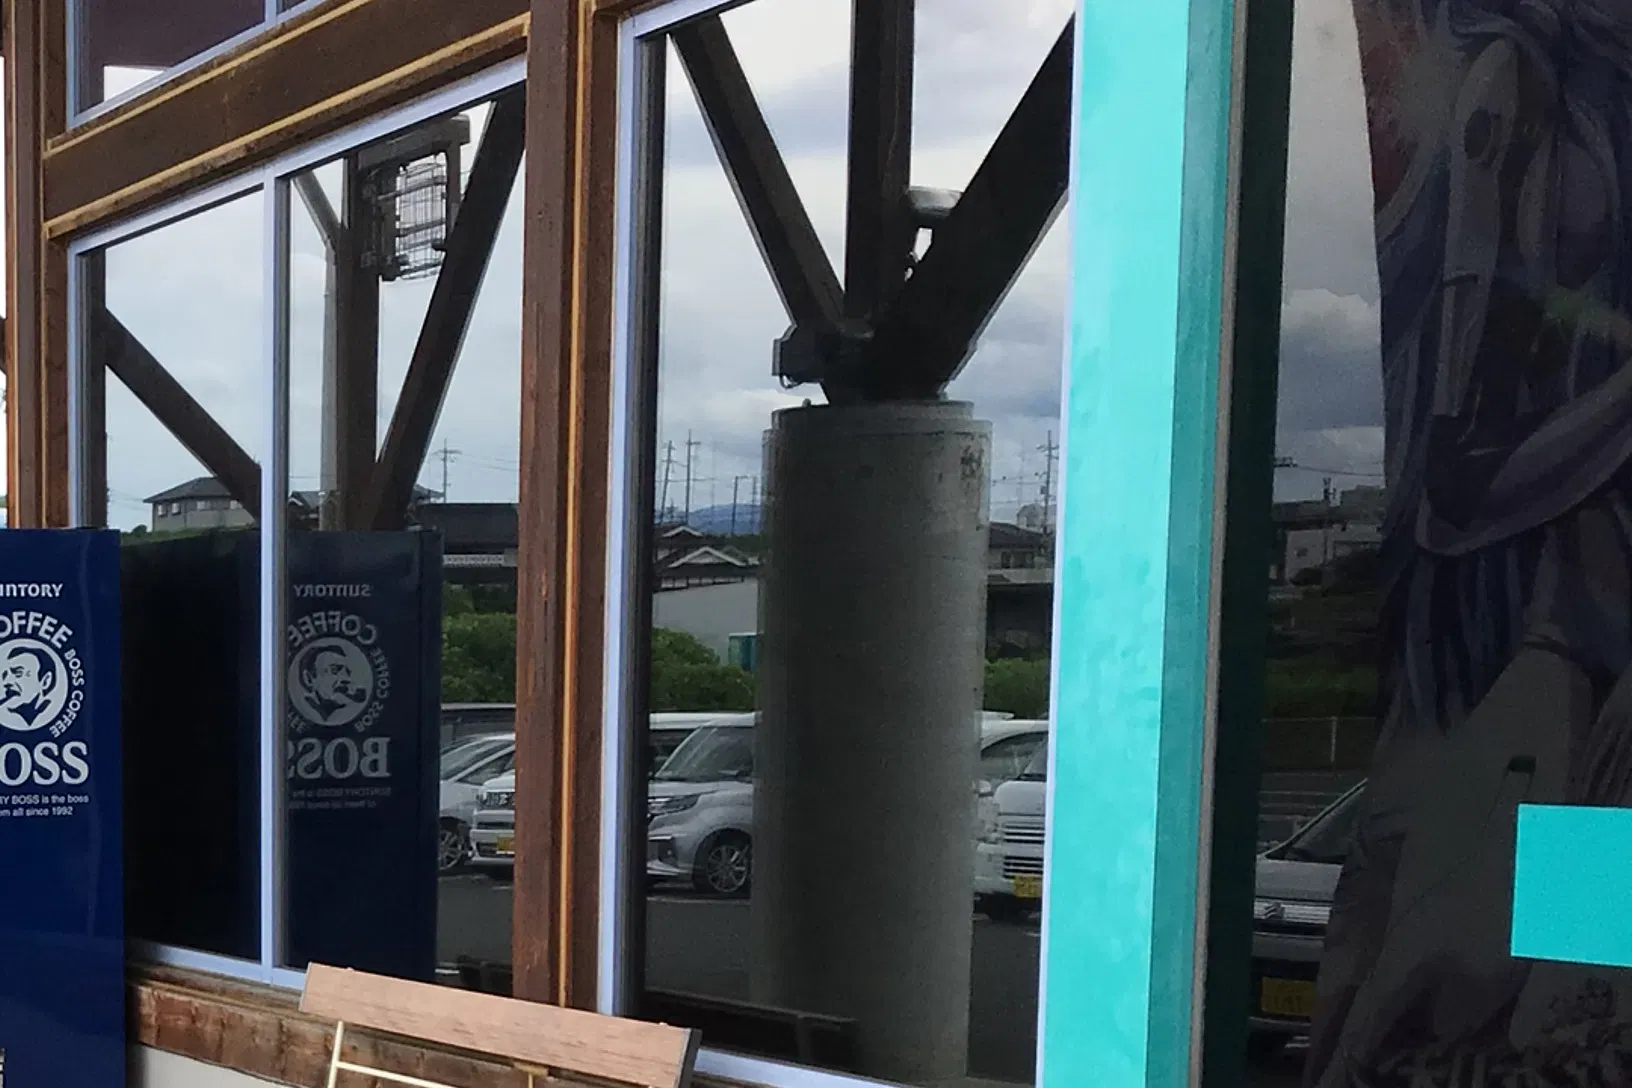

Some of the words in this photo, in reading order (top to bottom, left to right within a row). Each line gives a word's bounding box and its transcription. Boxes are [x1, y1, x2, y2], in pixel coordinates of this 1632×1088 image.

[64, 649, 85, 686] BOSS
[49, 690, 84, 738] COFFEE
[12, 795, 39, 804] BOSS
[51, 794, 65, 803] the
